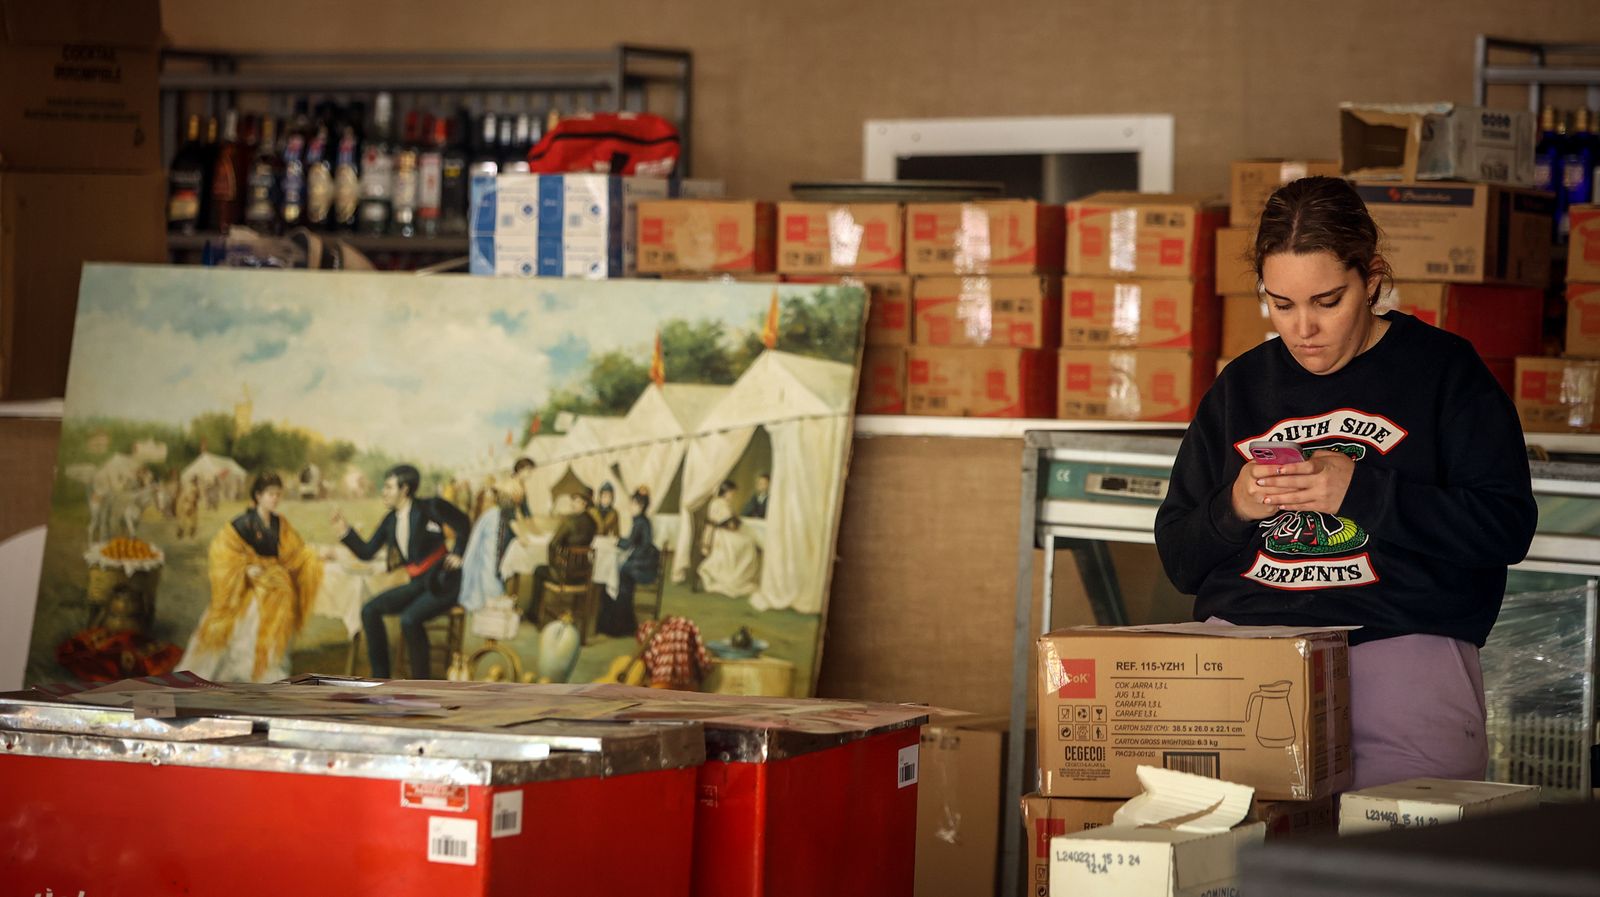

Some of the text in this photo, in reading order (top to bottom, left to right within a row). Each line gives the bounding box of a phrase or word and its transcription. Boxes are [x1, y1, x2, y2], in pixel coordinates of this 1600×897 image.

[1268, 417, 1393, 444] OUTH SIDE
[1254, 563, 1363, 583] SERPENTS
[1116, 661, 1185, 671] REF. 115-YZH1
[1203, 662, 1223, 672] CT6
[1115, 691, 1128, 699] JUG
[1141, 691, 1145, 699] L
[1216, 725, 1230, 733] 22.1
[1209, 739, 1218, 747] kg
[1064, 745, 1103, 761] CEGECO
[1415, 816, 1424, 826] 11
[1117, 853, 1124, 865] 3
[1128, 854, 1140, 866] 24
